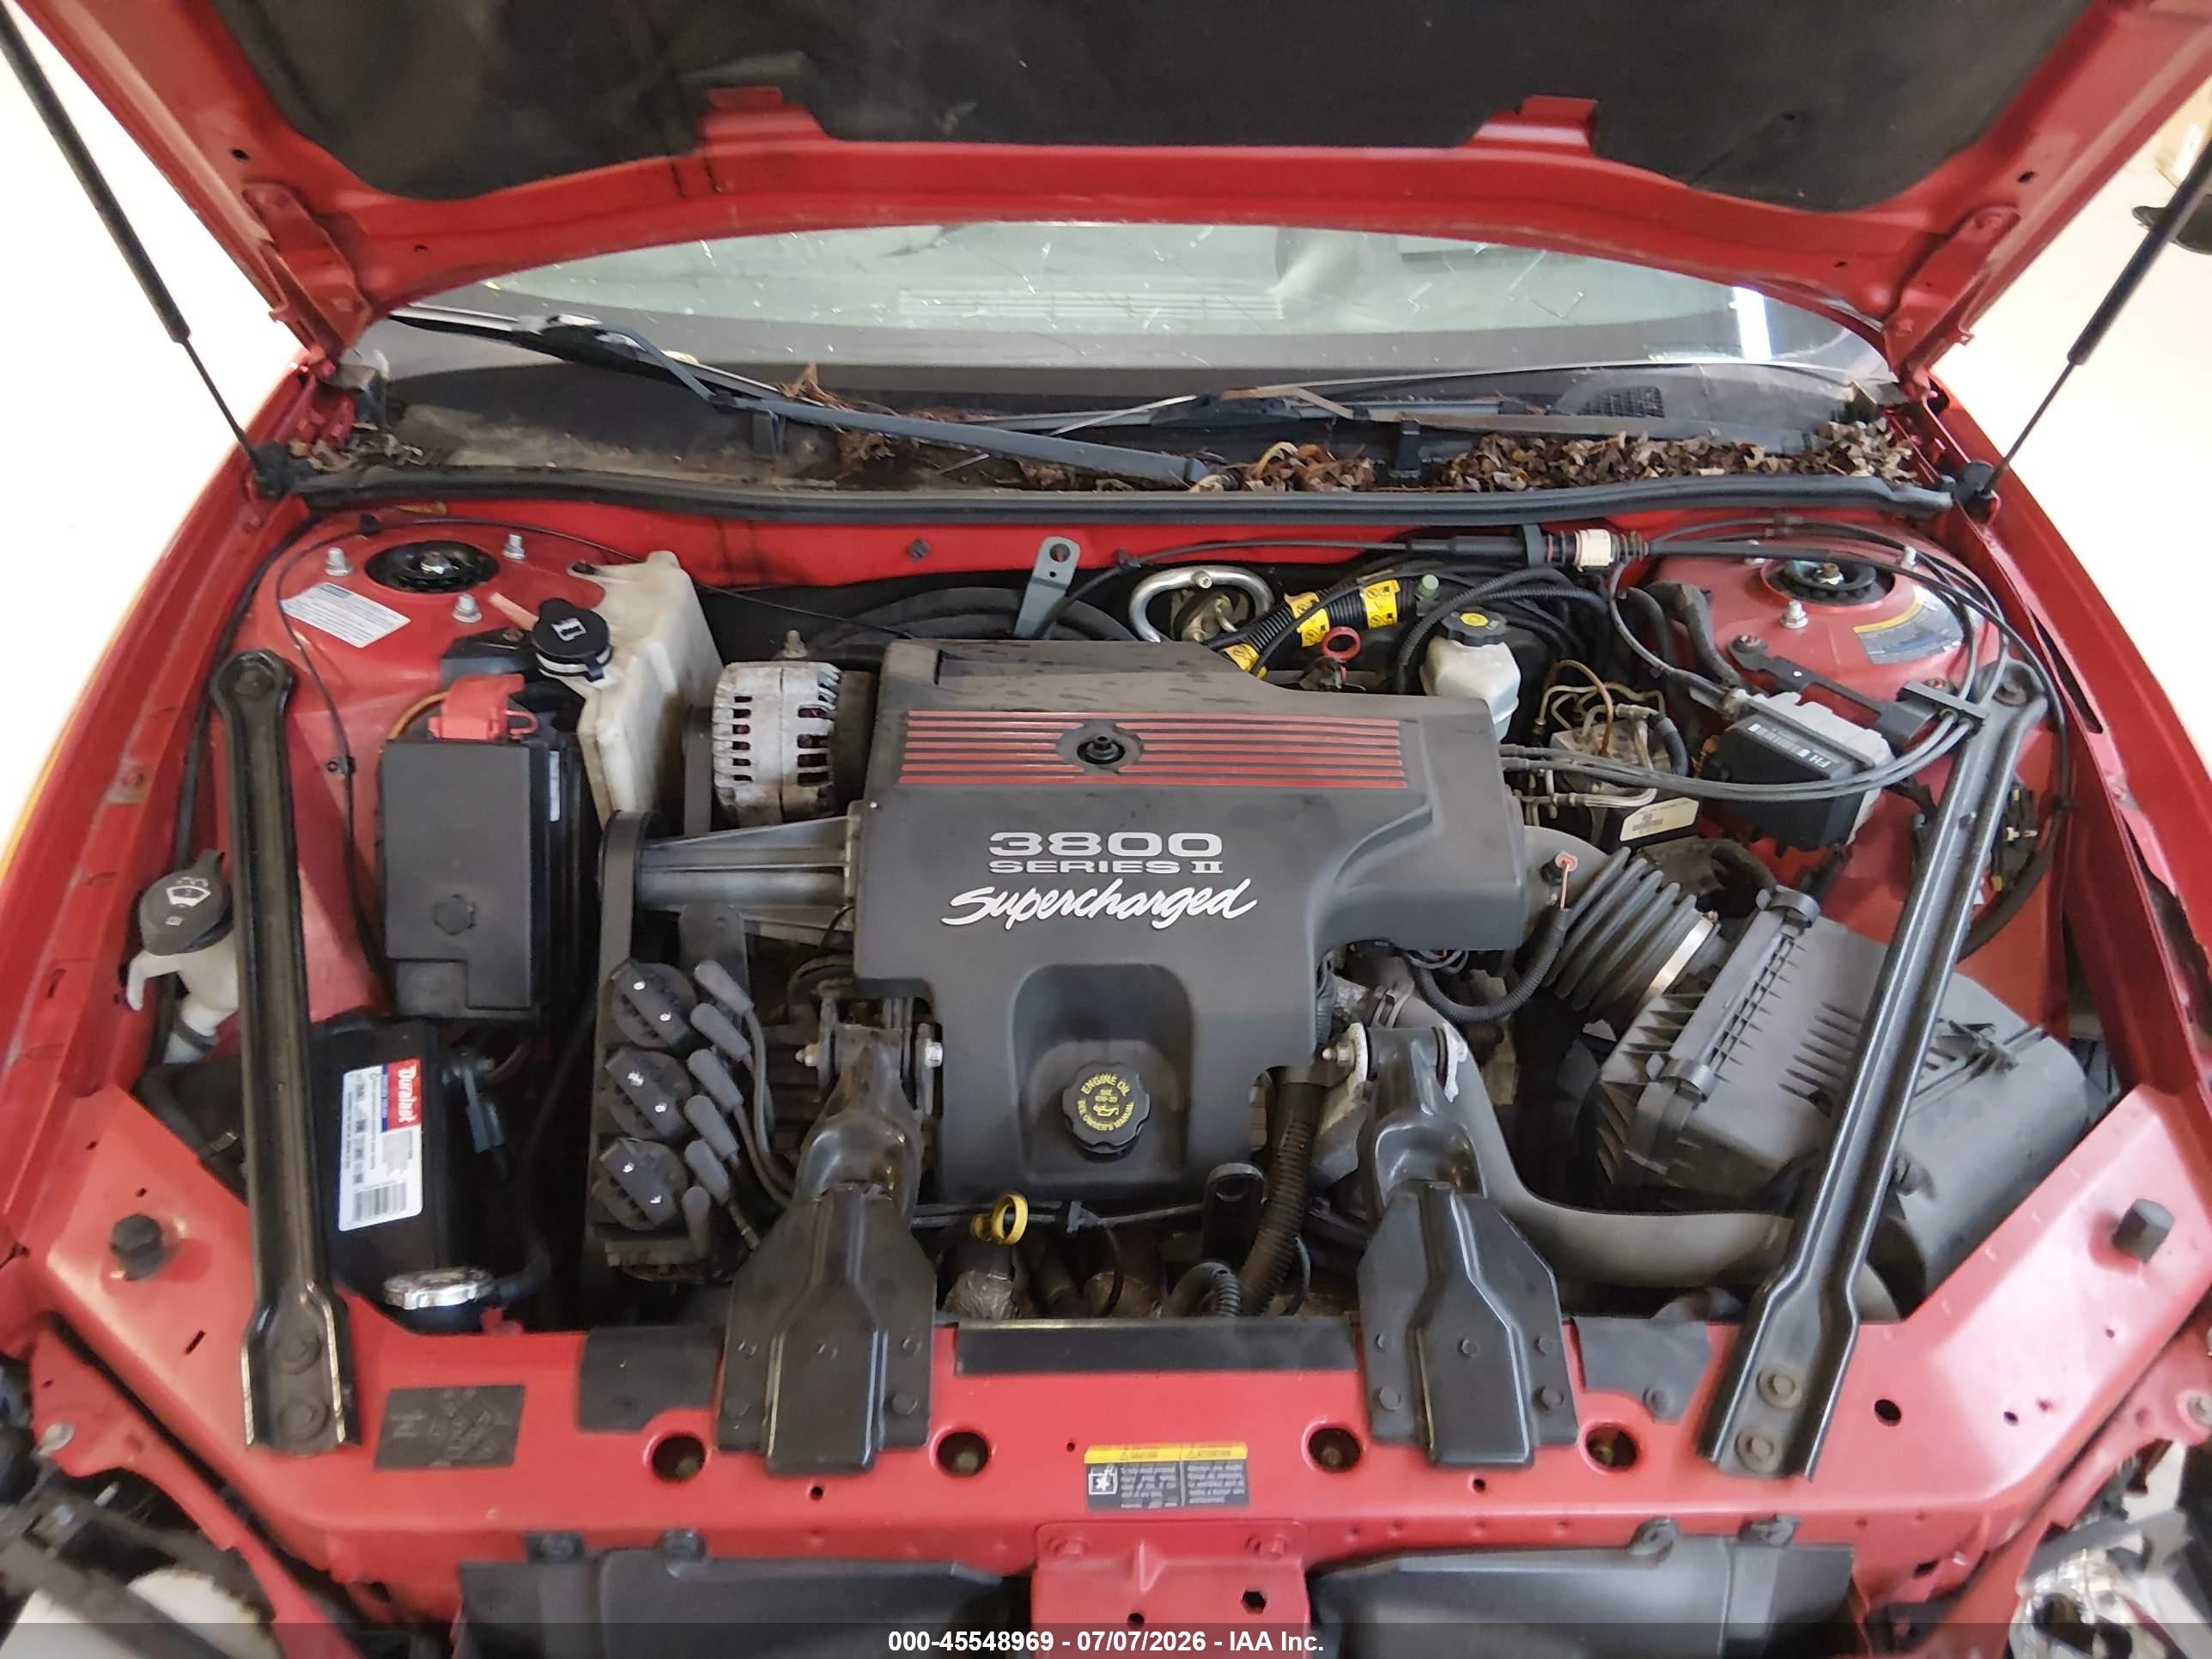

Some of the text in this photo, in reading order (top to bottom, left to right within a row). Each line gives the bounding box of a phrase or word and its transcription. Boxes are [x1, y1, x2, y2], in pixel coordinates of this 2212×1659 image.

[989, 832, 1223, 857] 3800
[989, 860, 1224, 873] SERIES II
[940, 878, 1258, 931] Supercharged
[398, 1065, 417, 1123] Duralast
[1080, 1073, 1131, 1097] ENGINE OIL
[1114, 1101, 1134, 1128] MANUAL
